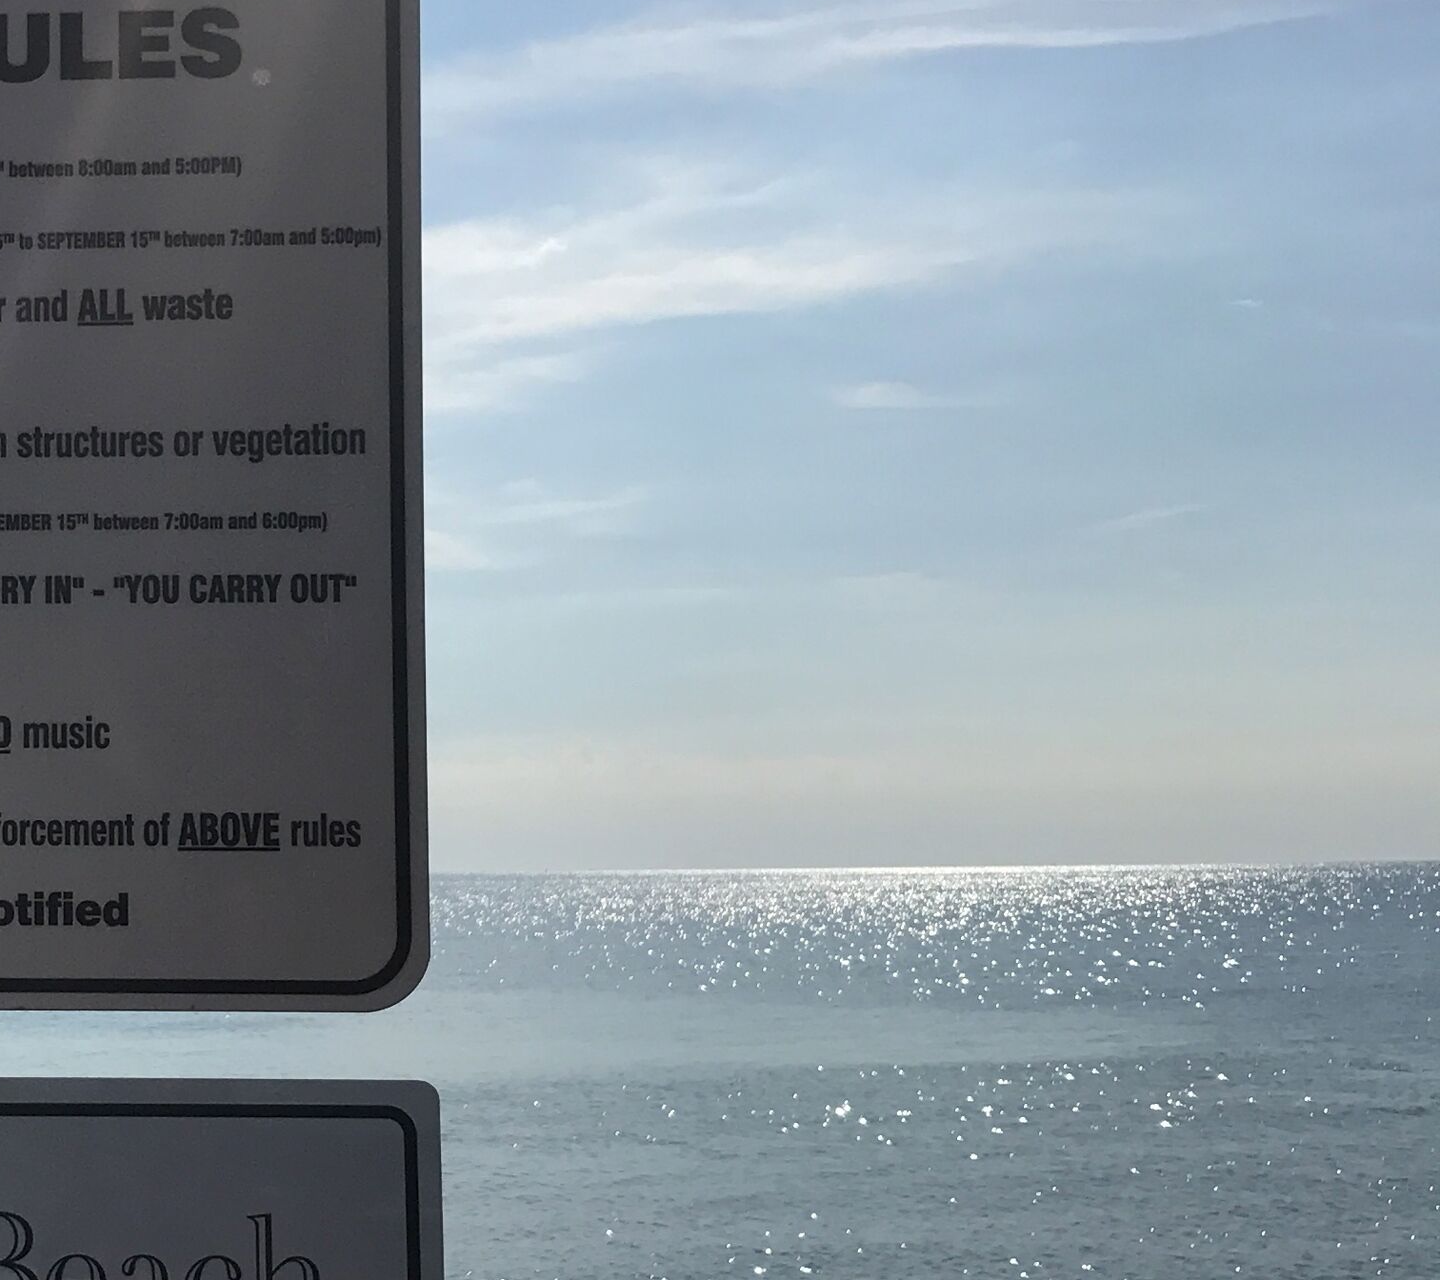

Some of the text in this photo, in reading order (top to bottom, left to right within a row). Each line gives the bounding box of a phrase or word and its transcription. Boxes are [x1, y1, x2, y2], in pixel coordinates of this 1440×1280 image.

[15, 289, 68, 322] and
[77, 288, 134, 327] ALL
[141, 289, 234, 321] waste
[16, 426, 164, 458] structures
[173, 431, 204, 457] or
[211, 423, 366, 462] vegetation
[189, 574, 282, 604] CARRY
[23, 716, 111, 750] music
[143, 812, 170, 847] of
[177, 812, 281, 852] ABOVE
[290, 812, 362, 847] rules
